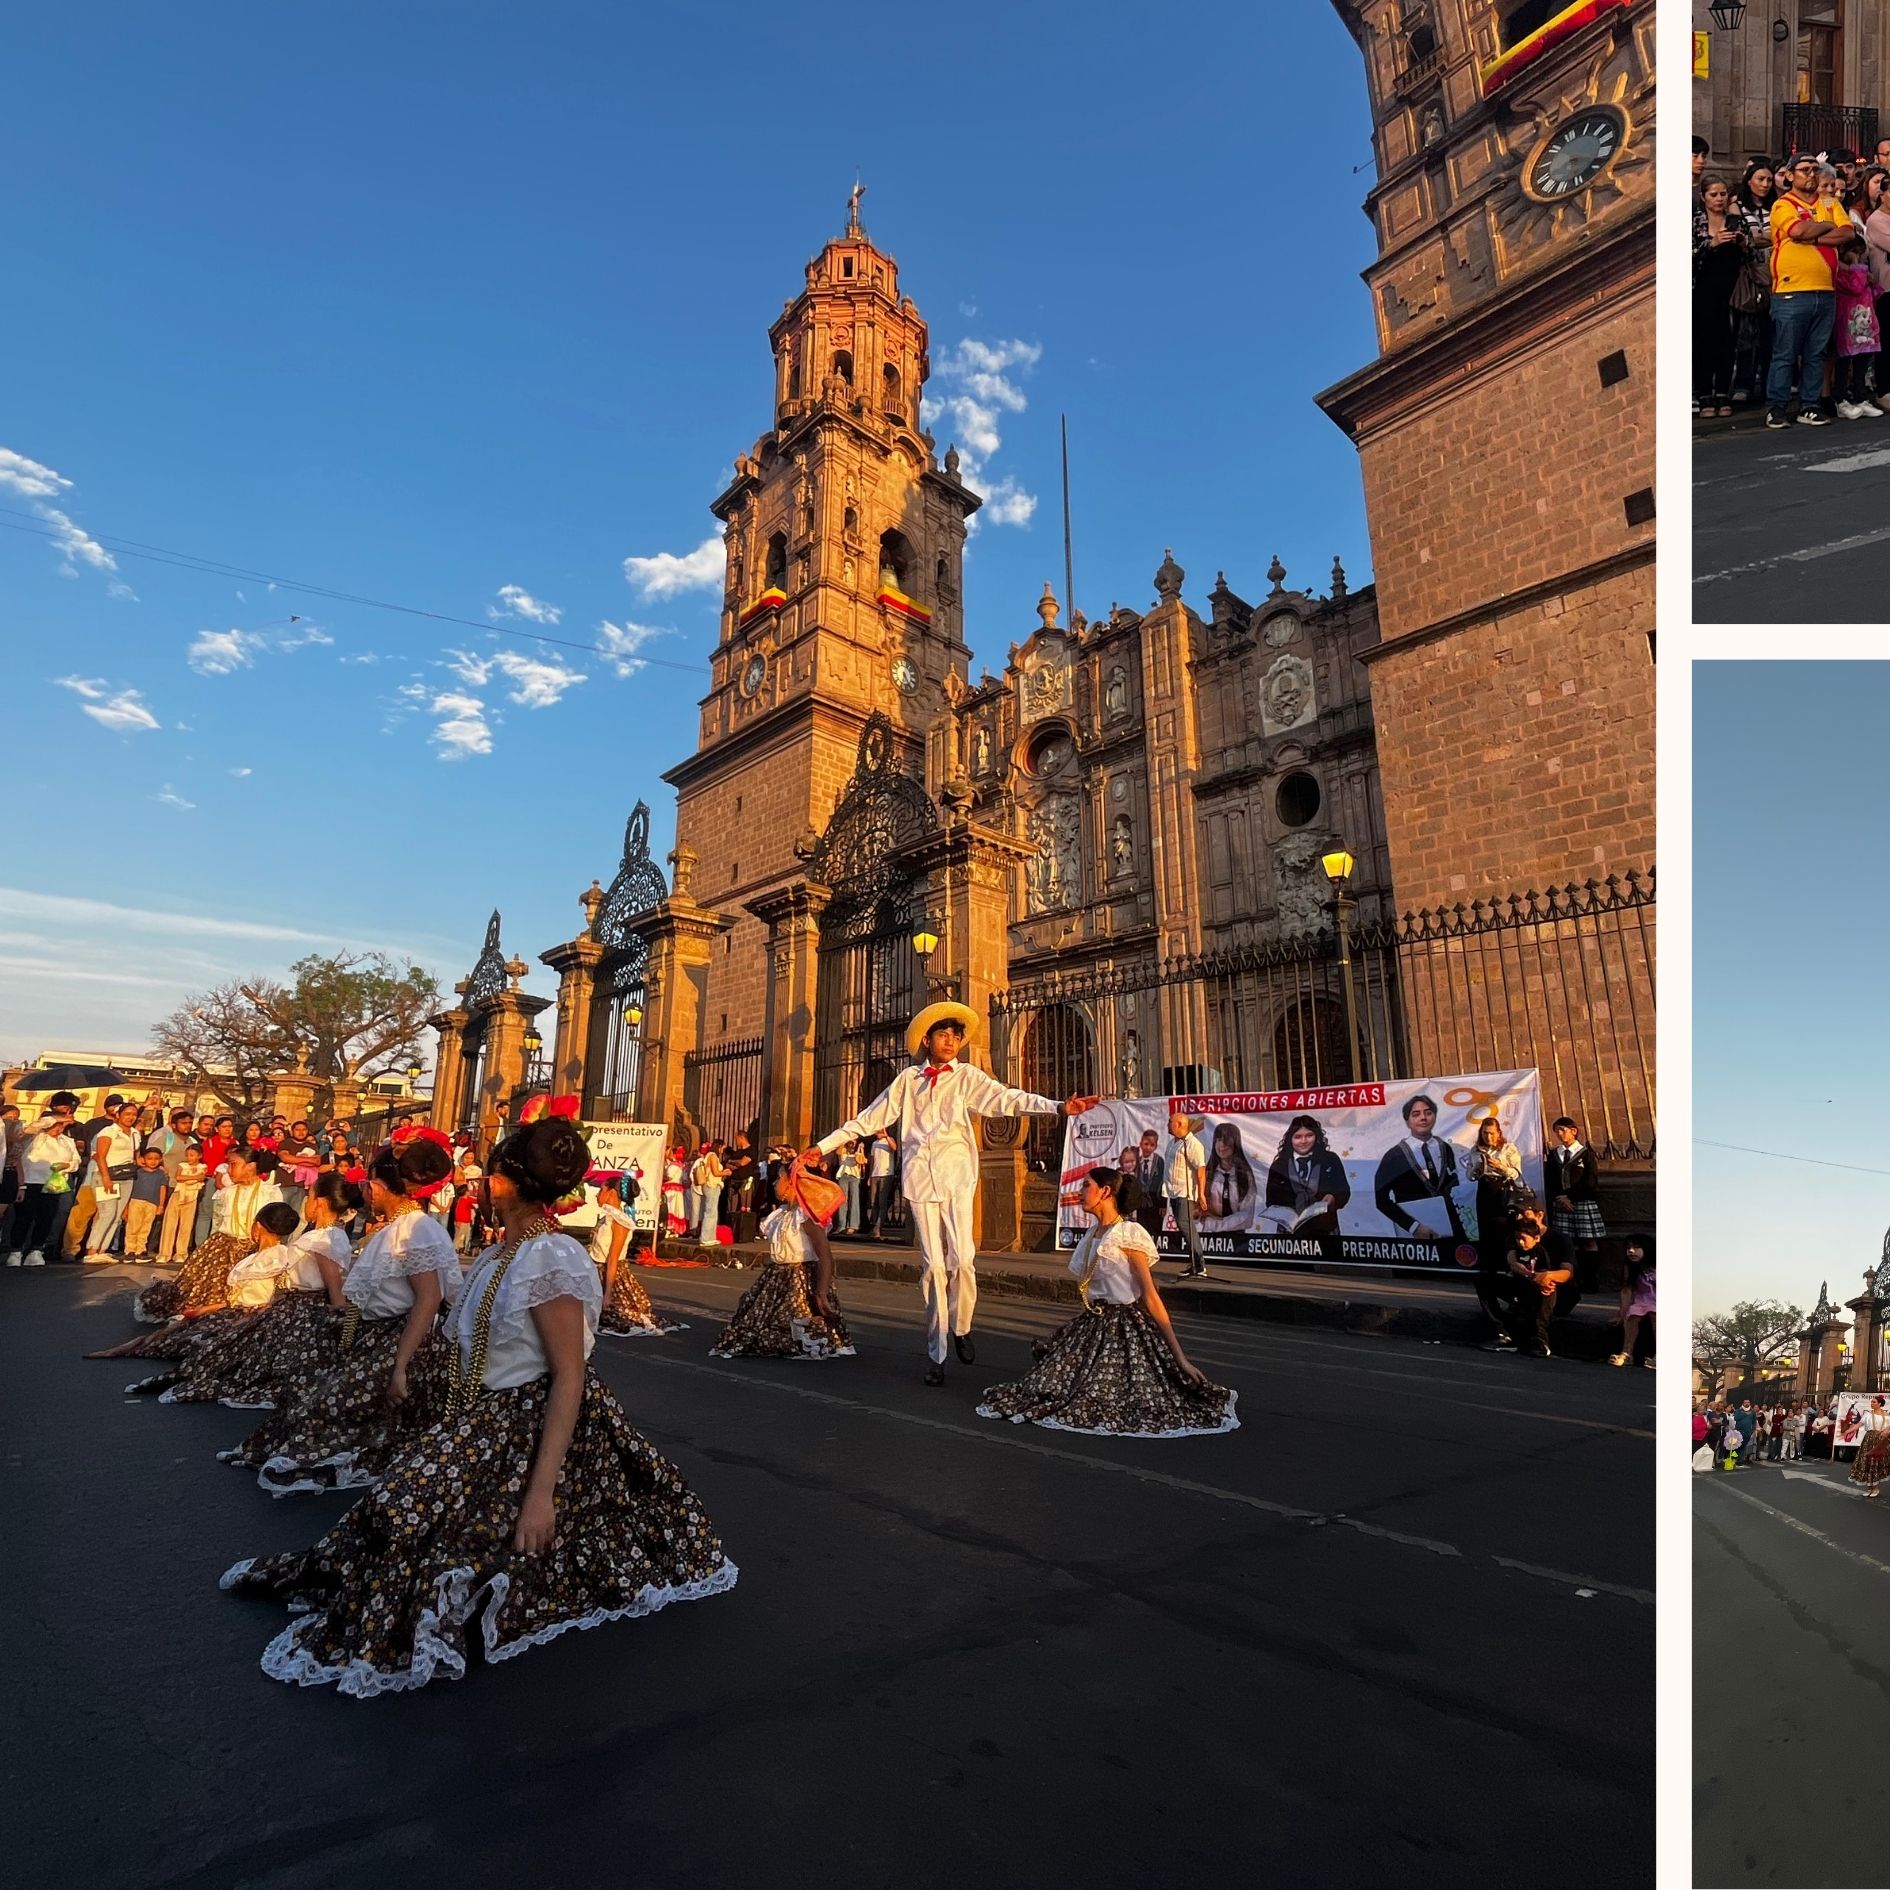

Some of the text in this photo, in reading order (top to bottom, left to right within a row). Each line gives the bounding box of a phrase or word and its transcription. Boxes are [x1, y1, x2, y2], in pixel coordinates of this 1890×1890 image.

[1174, 1087, 1381, 1113] INSCRIPCIONES ABIERTAS
[592, 1126, 663, 1136] presentativo
[1089, 1129, 1114, 1137] KELSEN
[597, 1139, 613, 1150] De
[593, 1155, 641, 1170] ANZA
[1247, 1238, 1323, 1256] SECUNDARIA
[1342, 1240, 1440, 1262] PREPARATORIA
